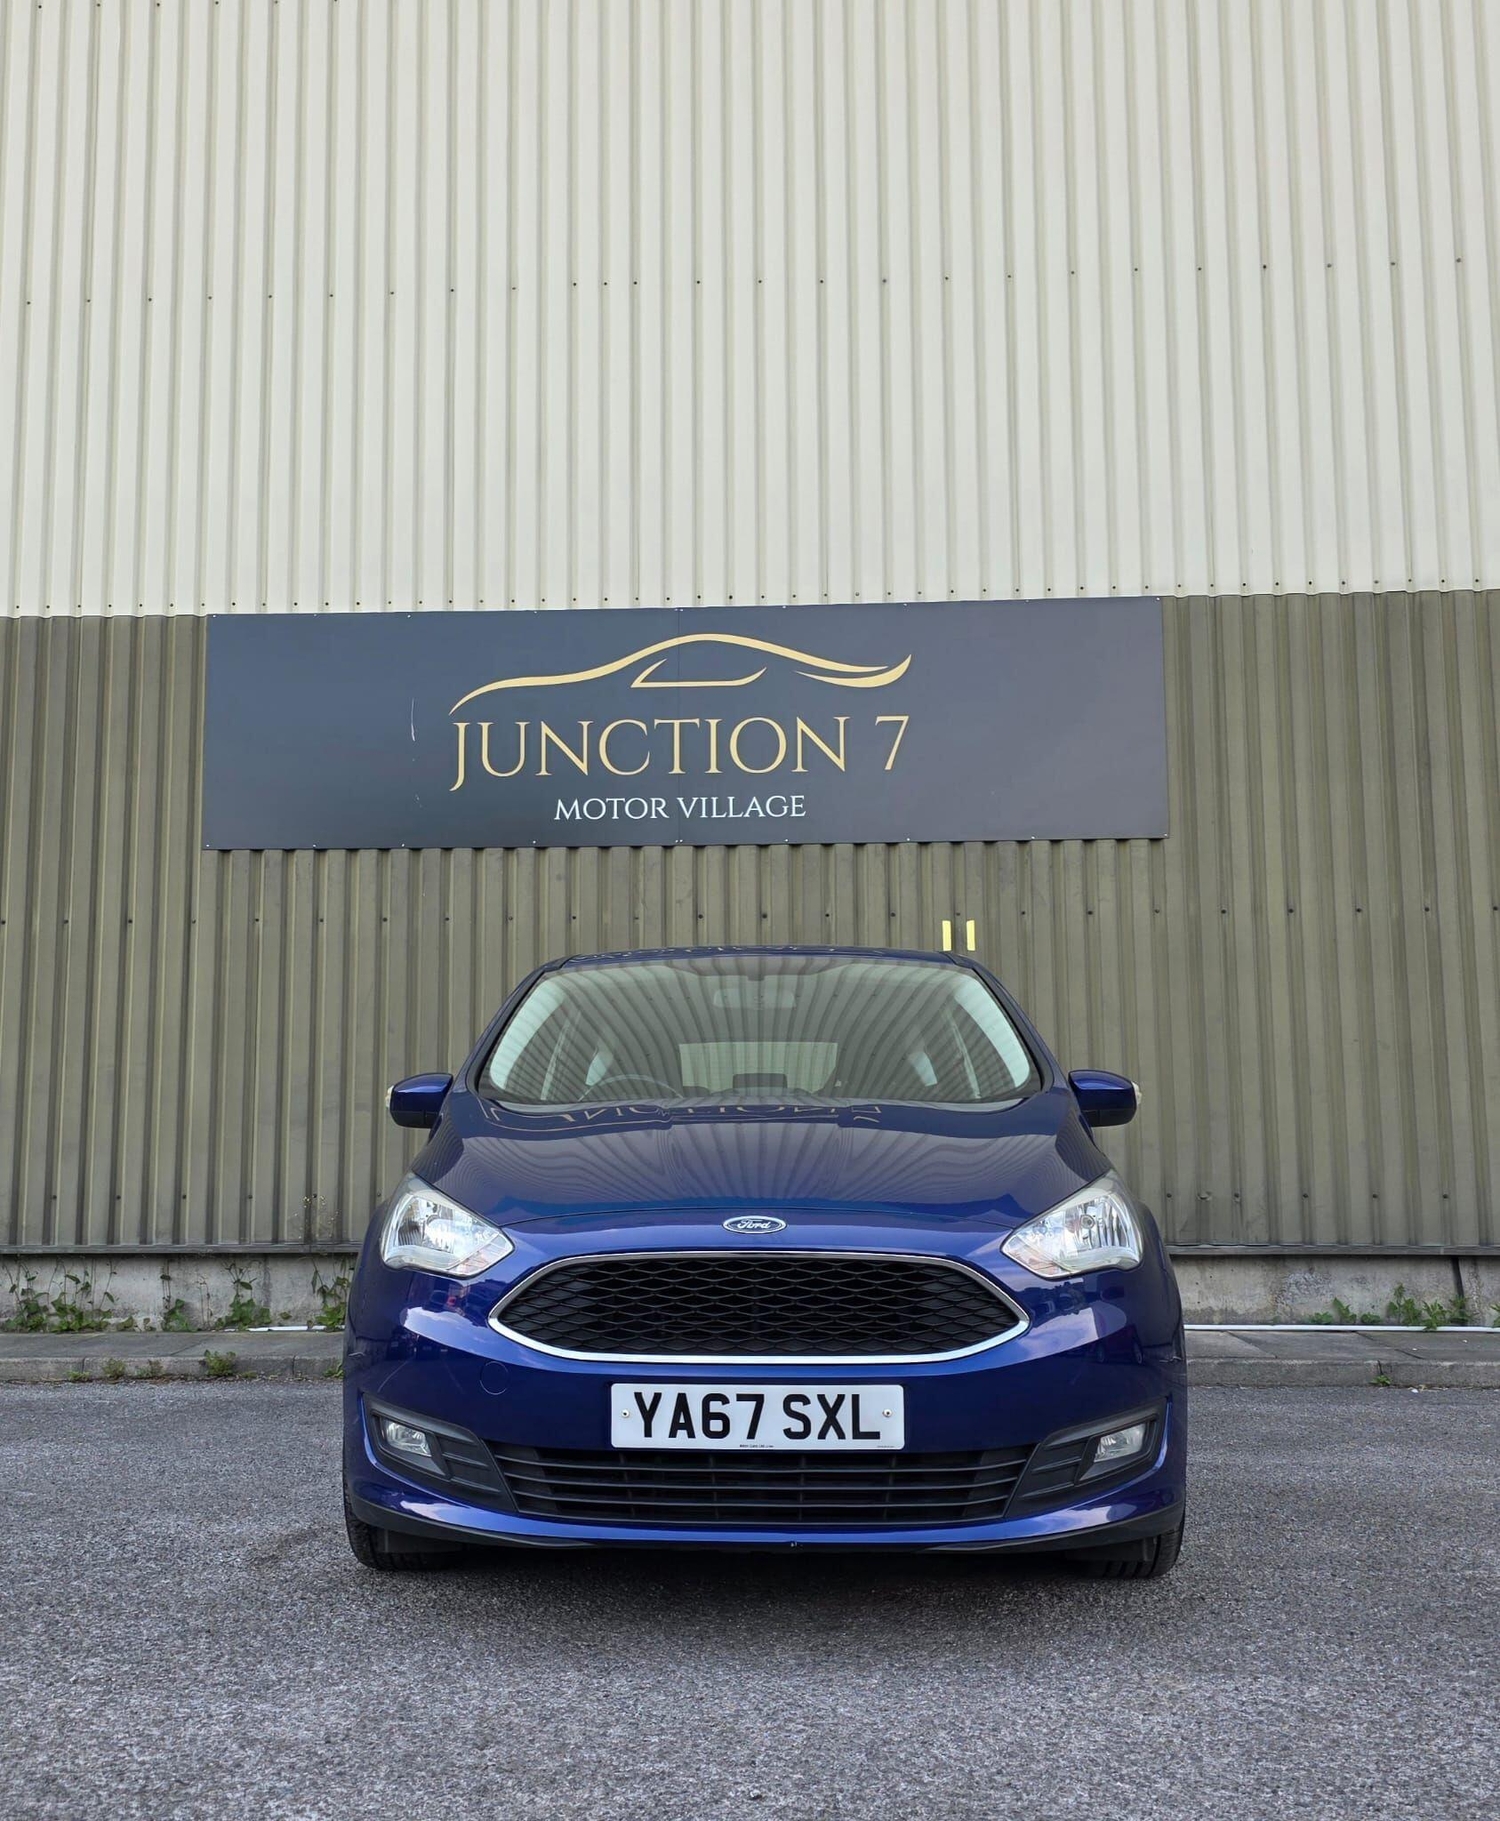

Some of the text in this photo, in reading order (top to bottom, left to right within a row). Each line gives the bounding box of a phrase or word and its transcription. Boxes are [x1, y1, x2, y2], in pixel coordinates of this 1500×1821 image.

[449, 715, 910, 792] JUNCTION 7
[554, 794, 807, 821] MOTOR VILLAGE
[736, 1218, 772, 1230] Ford
[633, 1392, 881, 1441] YA67 SXL
